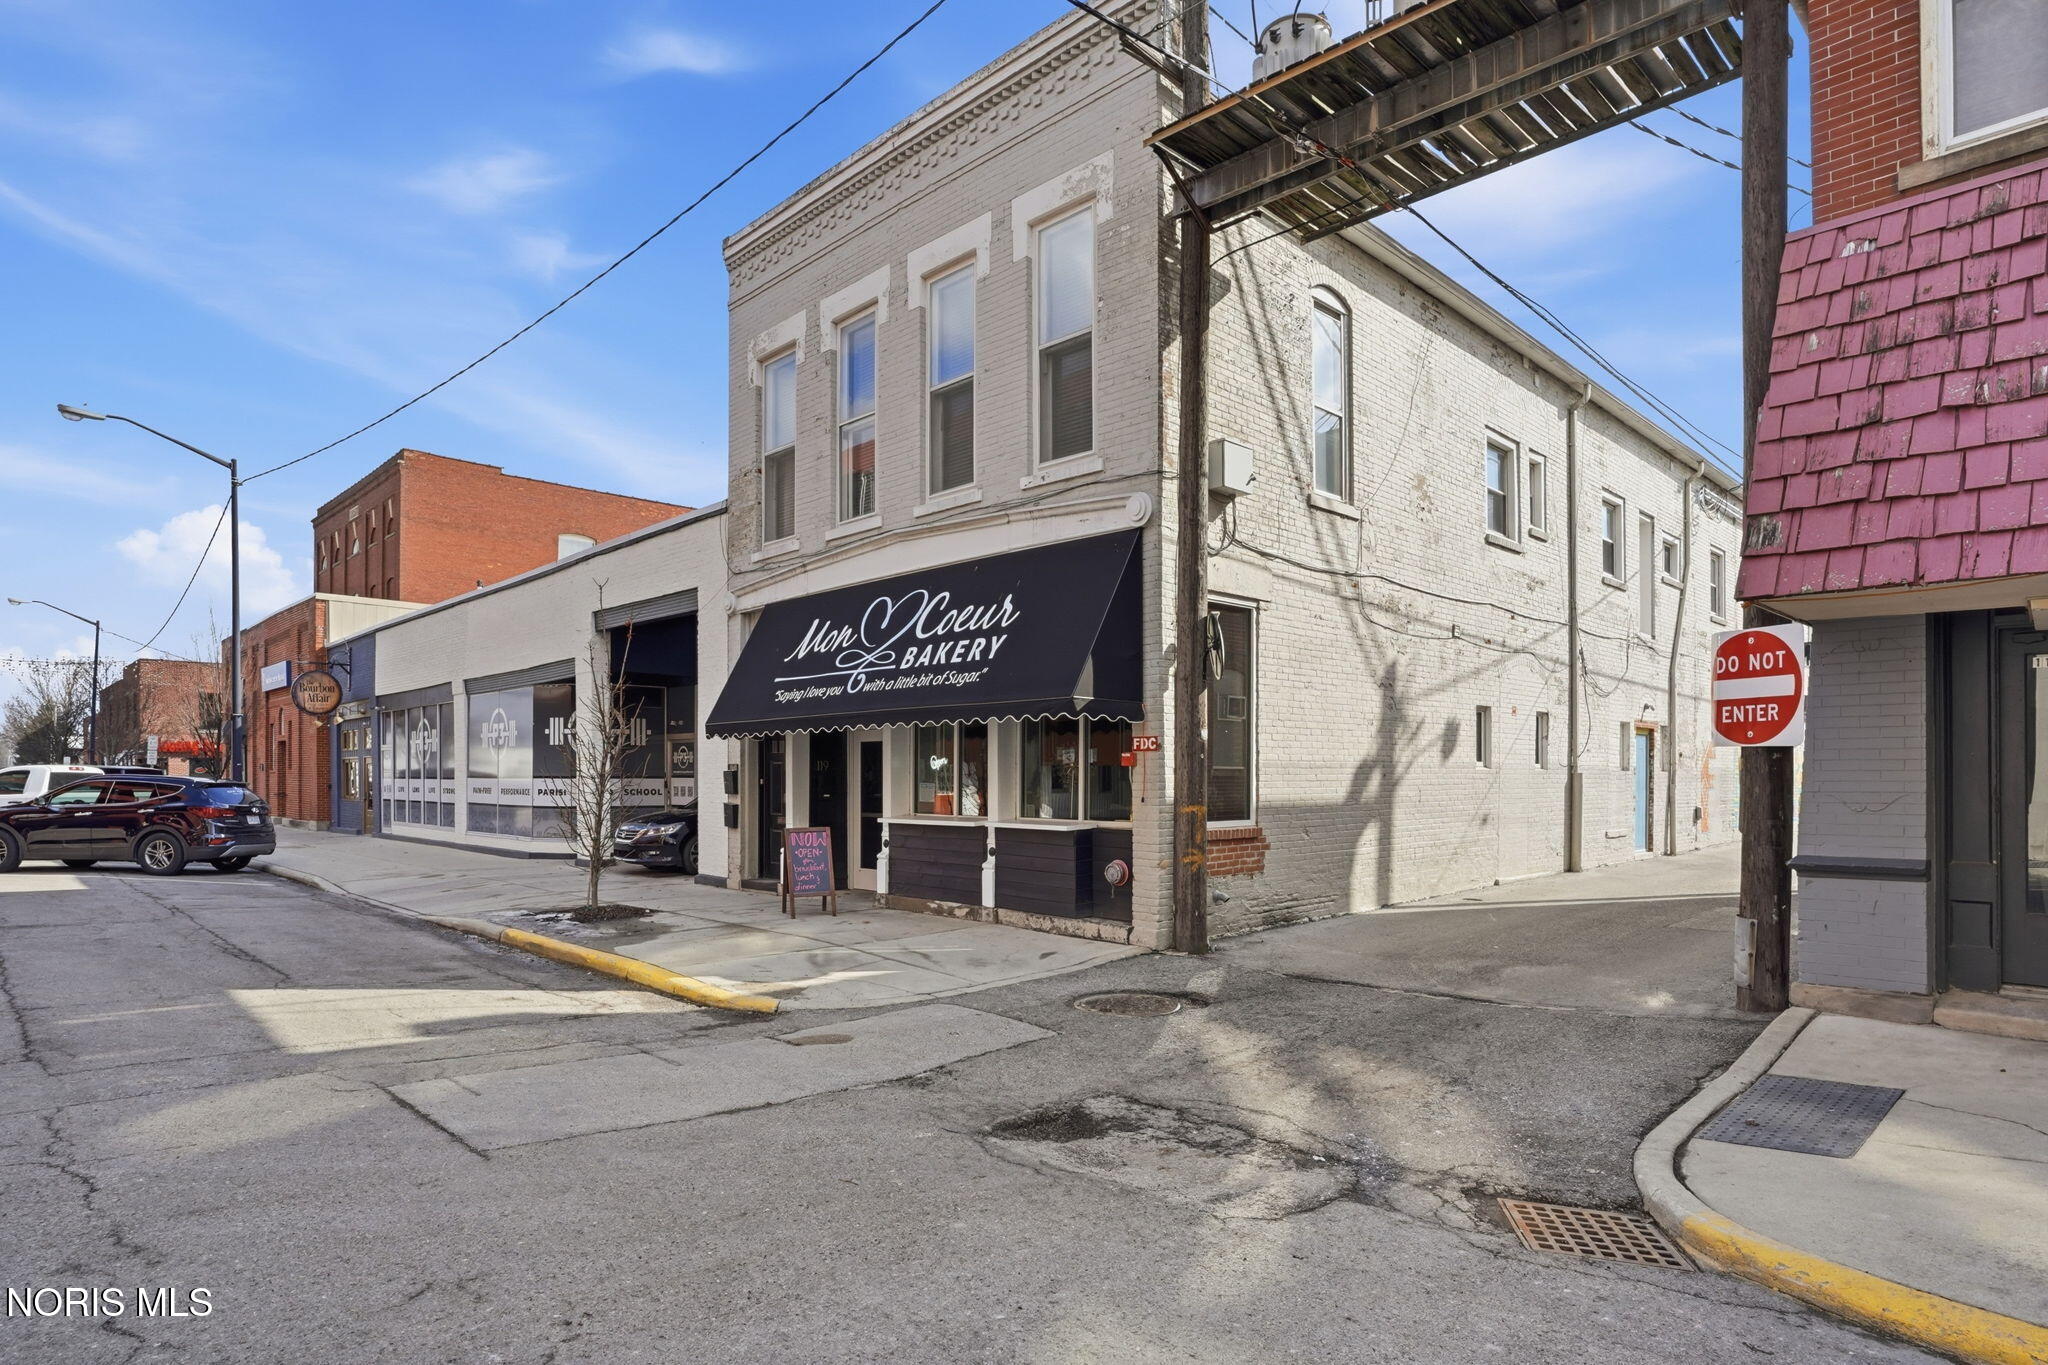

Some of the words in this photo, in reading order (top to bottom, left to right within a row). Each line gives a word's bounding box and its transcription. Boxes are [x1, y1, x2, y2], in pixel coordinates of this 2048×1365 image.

[784, 618, 858, 662] Mon
[915, 591, 1020, 639] Coeur
[899, 634, 1008, 669] BAKERY
[1716, 655, 1740, 674] DO
[1748, 650, 1786, 671] NOT
[299, 681, 335, 692] Bourbon
[807, 685, 827, 698] love
[823, 685, 845, 699] you
[862, 677, 885, 692] with
[885, 680, 894, 690] a
[893, 674, 918, 690] little
[916, 673, 934, 687] bit
[932, 670, 951, 685] of
[307, 692, 330, 703] Affair
[1722, 703, 1779, 723] ENTER
[1133, 737, 1157, 750] FDC
[500, 787, 531, 796] PERFORMANCE
[623, 788, 663, 796] SCHOOL
[790, 832, 827, 846] NOW
